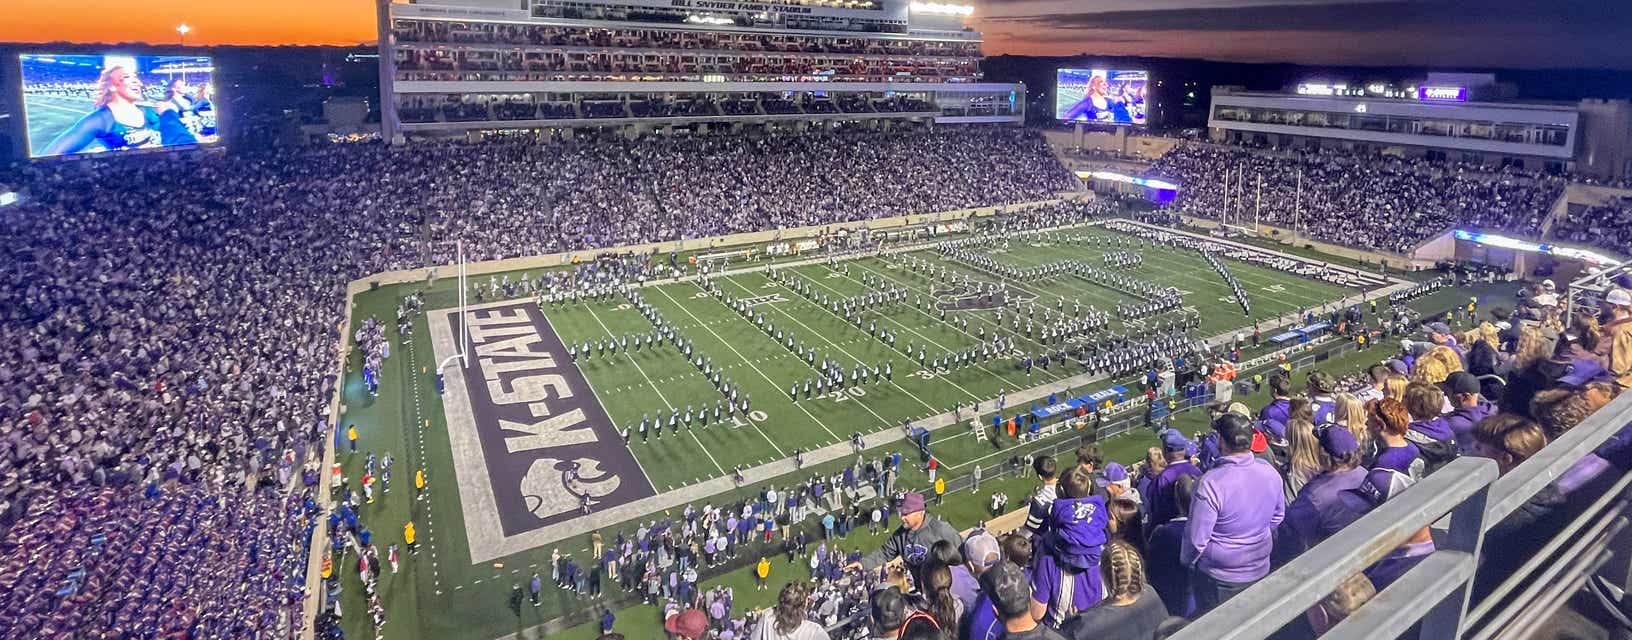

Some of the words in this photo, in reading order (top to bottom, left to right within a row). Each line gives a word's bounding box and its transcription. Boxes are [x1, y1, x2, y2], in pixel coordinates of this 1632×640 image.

[696, 1, 735, 9] SNYDER
[738, 3, 769, 11] FAMILY
[467, 308, 599, 453] K-STATE
[828, 386, 867, 402] 20
[731, 410, 768, 429] 10
